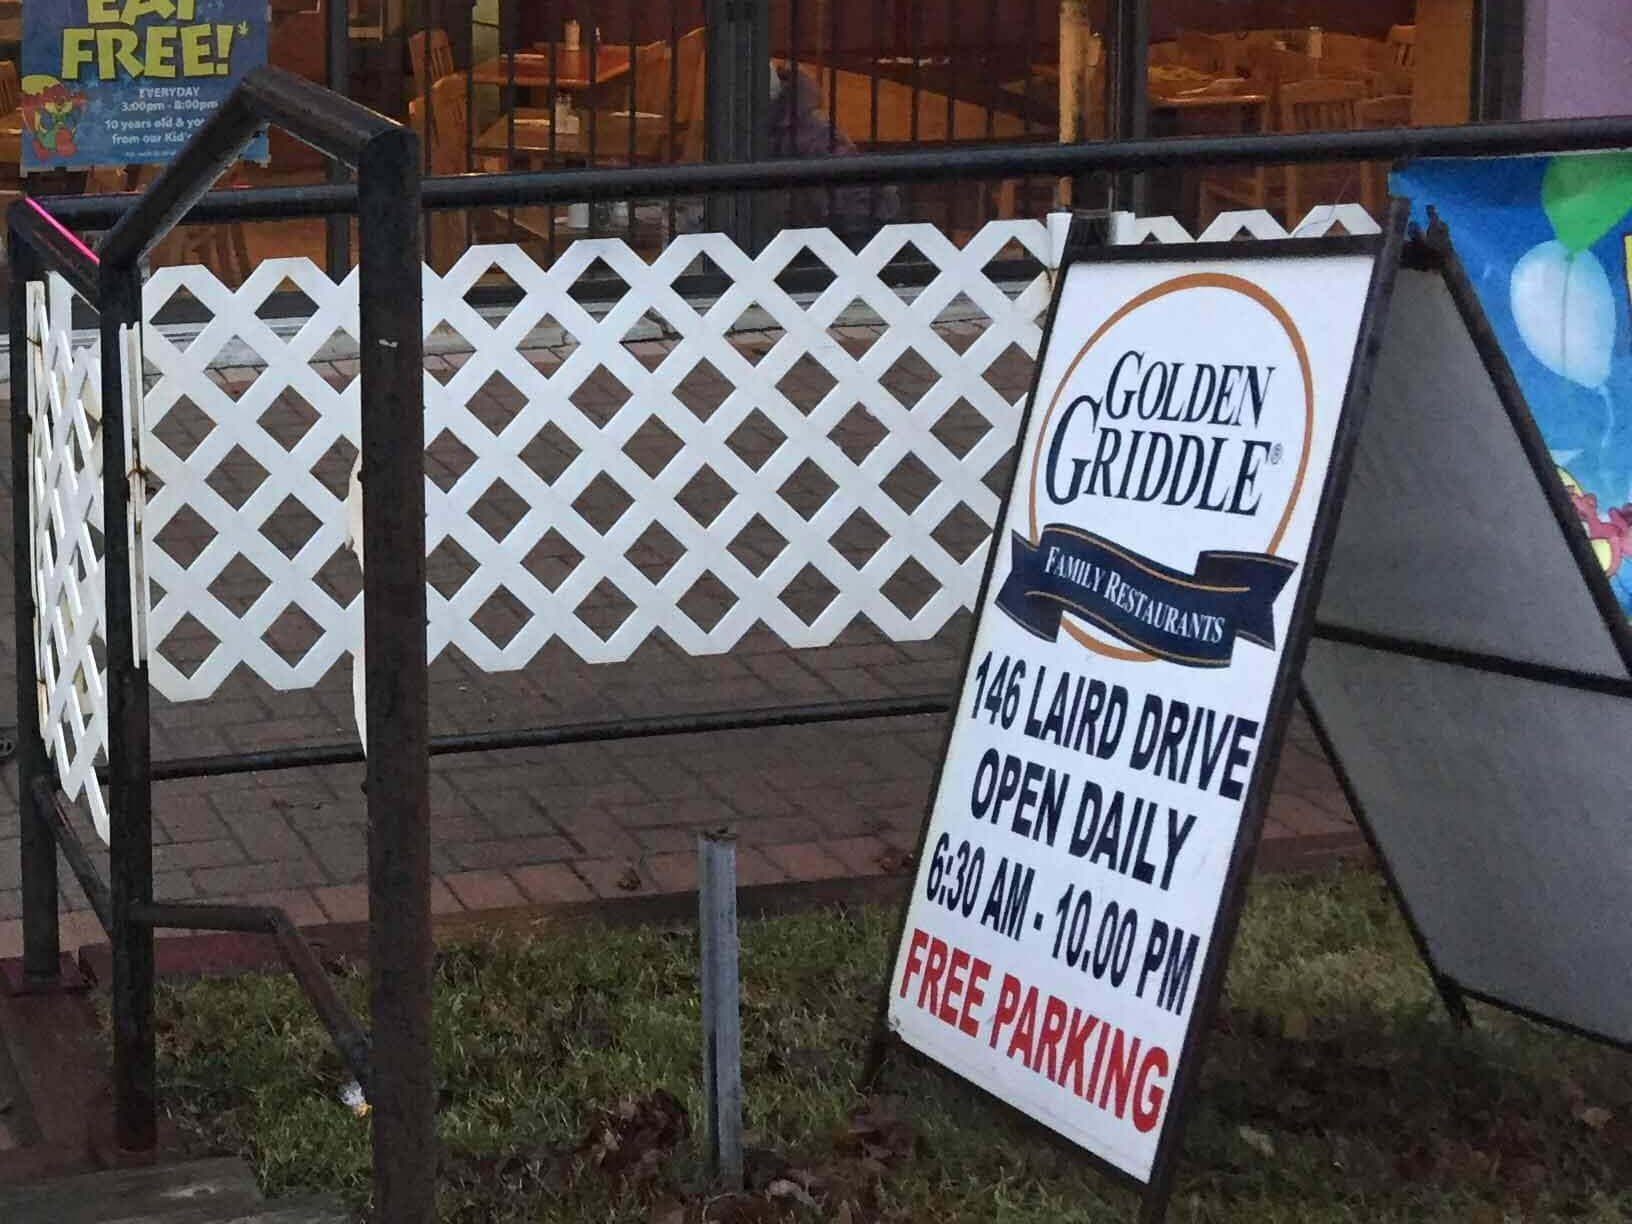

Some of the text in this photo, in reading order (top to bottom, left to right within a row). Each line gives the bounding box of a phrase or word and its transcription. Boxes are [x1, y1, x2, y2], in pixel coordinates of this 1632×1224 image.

[105, 120, 118, 130] 10
[121, 120, 151, 131] years
[154, 116, 173, 128] old
[176, 117, 185, 128] &
[111, 133, 140, 145] from
[143, 134, 162, 144] our
[139, 86, 201, 99] EVERYDAY
[1106, 350, 1276, 428] GOLDEN
[1044, 546, 1225, 644] FAMILY RESTAURANTS
[970, 650, 1260, 802] 146 LAIRD DRIVE
[971, 747, 1197, 891] OPEN DAILY
[926, 831, 986, 919] 6:30
[981, 856, 1035, 942] AM
[1052, 883, 1138, 988] 10.00
[1137, 919, 1200, 1016] PM
[899, 927, 1169, 1134] FREE PARKING
